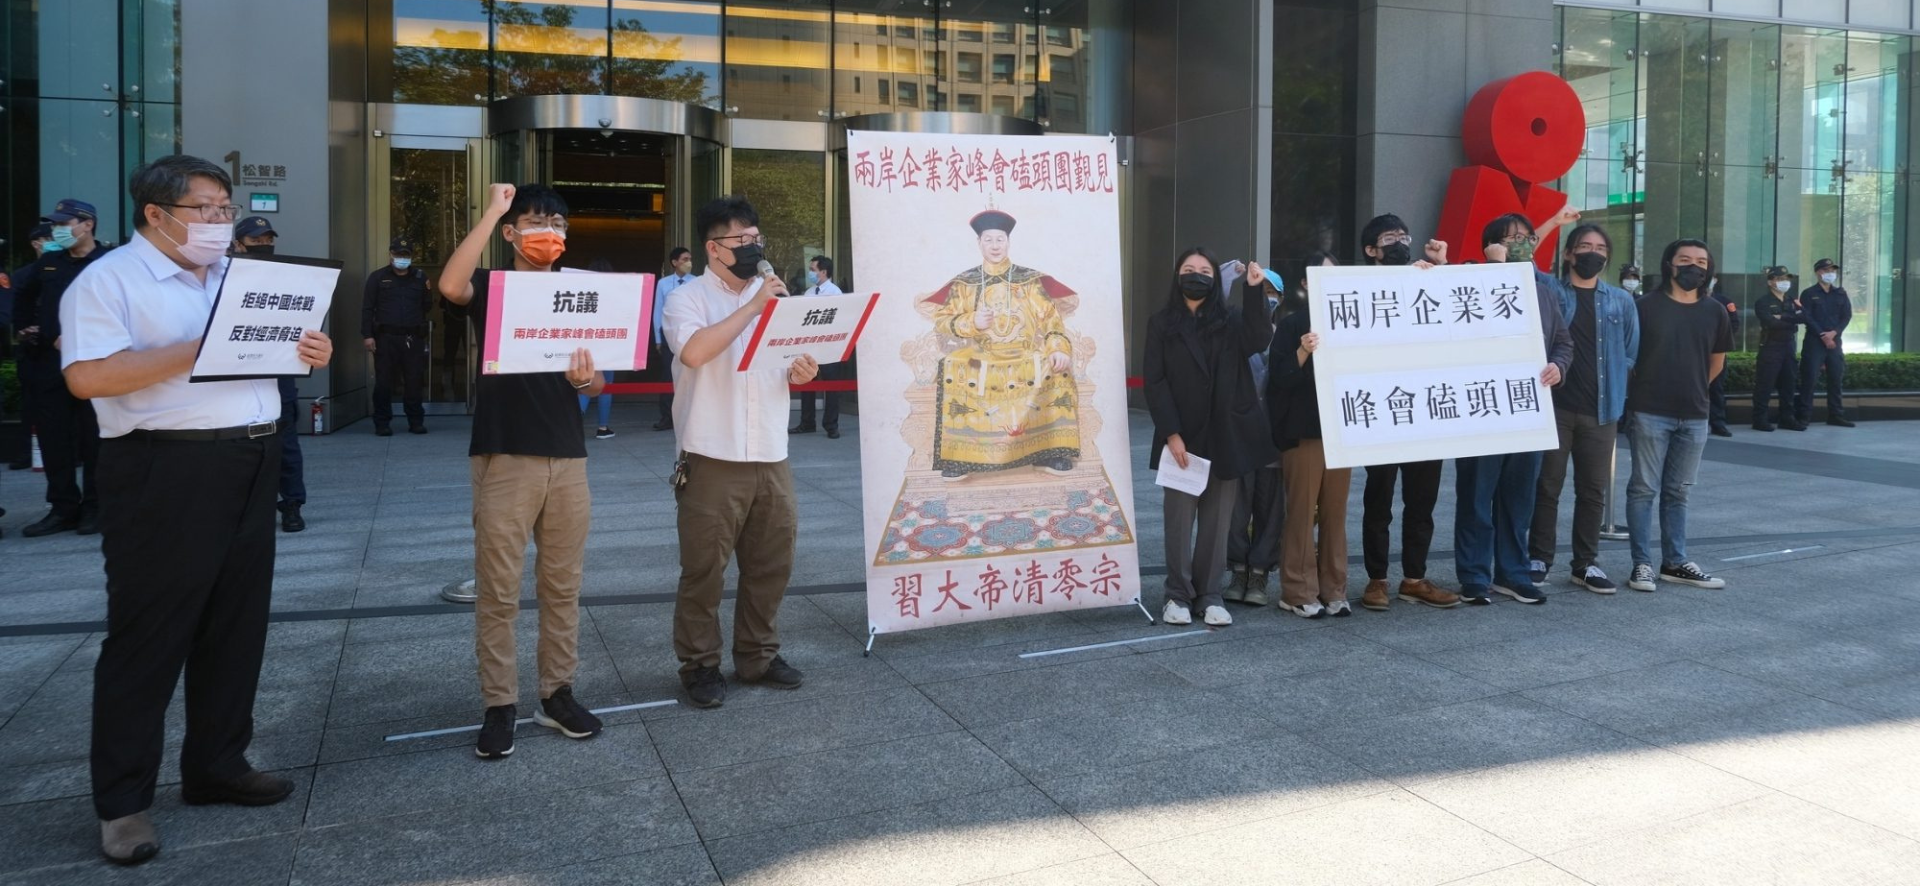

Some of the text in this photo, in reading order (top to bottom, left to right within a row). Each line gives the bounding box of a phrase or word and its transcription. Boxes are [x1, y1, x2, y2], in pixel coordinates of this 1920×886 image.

[224, 150, 286, 186] 1 松智路
[241, 291, 315, 312] 拒絕中國統戰
[553, 290, 599, 314] 抗議
[1326, 283, 1524, 330] 兩岸企業家
[801, 307, 838, 326] 抗議
[228, 325, 302, 342] 反對經濟脅迫
[513, 328, 628, 340] 兩岸企業家峰會磕頭團
[1340, 376, 1541, 429] 峰會磕頭團
[891, 553, 1122, 619] 習大帝清零宗
